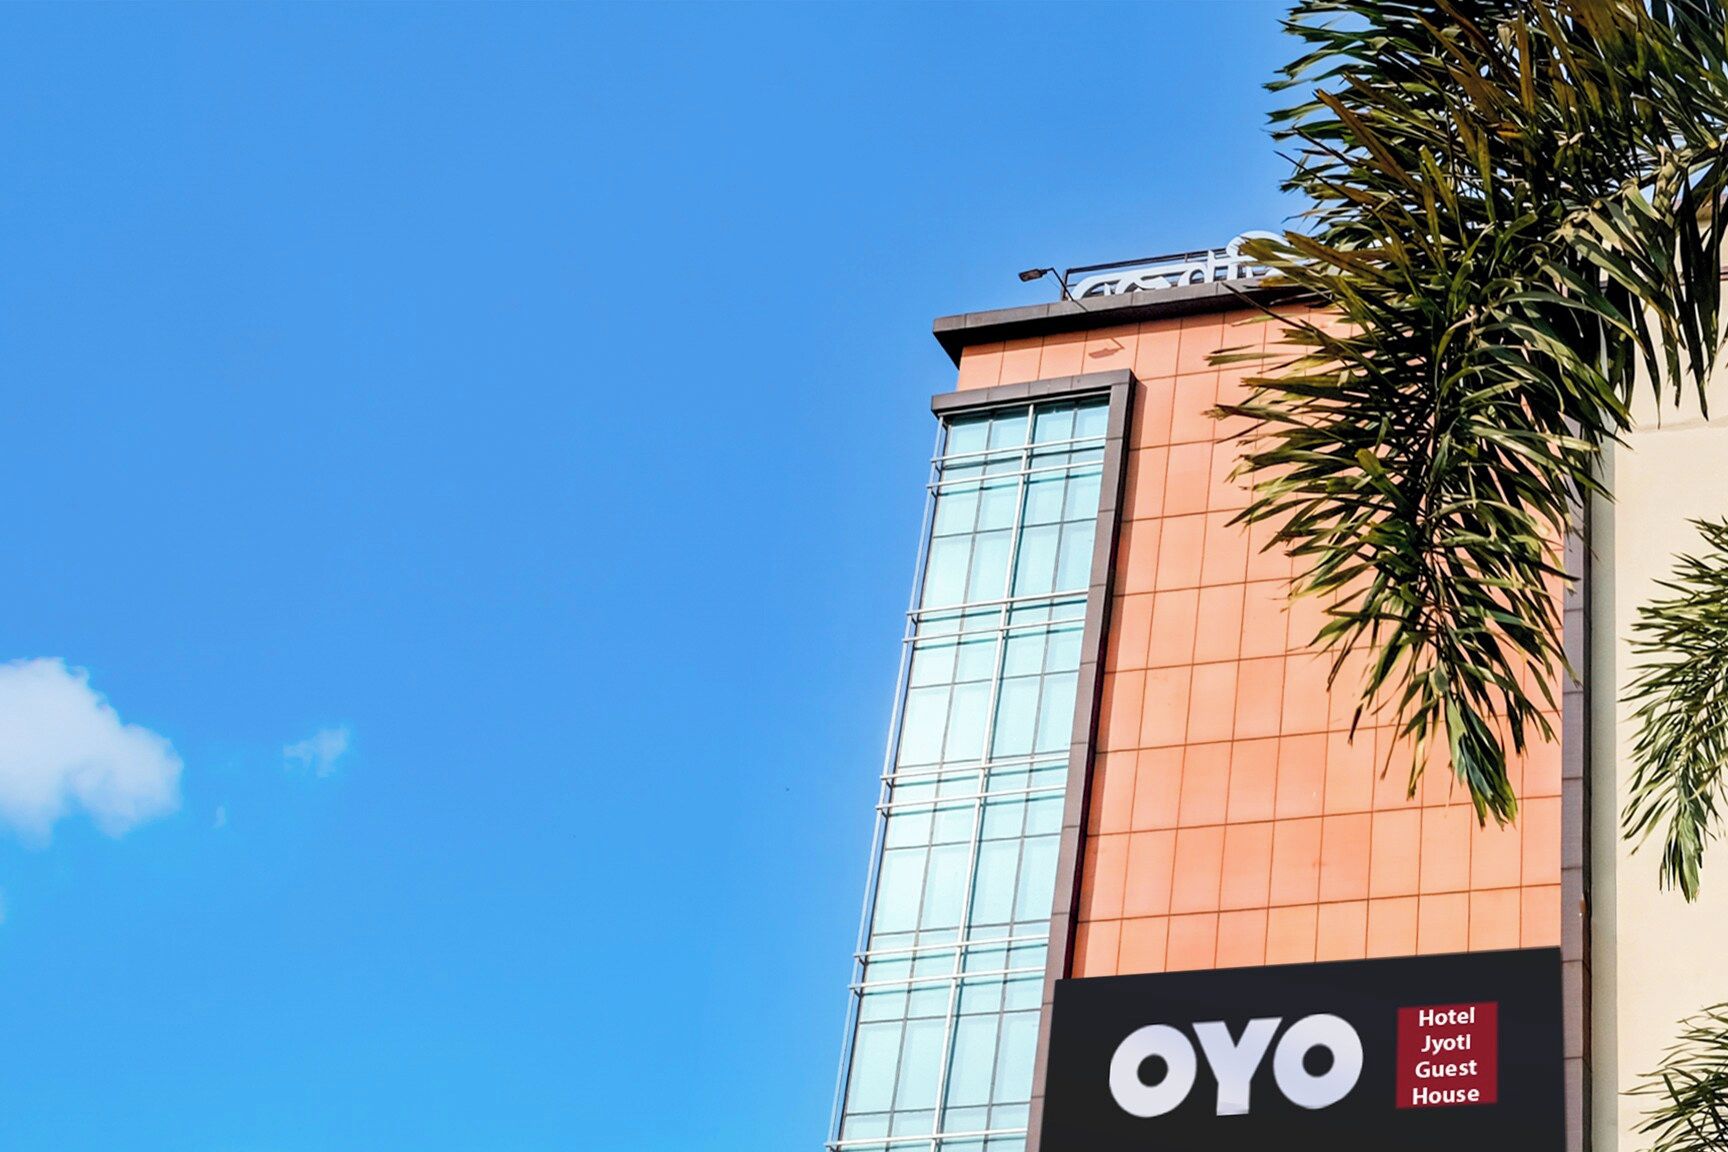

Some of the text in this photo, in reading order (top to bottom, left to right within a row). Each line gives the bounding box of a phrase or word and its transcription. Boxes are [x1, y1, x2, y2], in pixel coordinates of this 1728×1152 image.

[1419, 1006, 1475, 1027] Hotel
[1421, 1033, 1471, 1055] Jyoti
[1109, 1013, 1364, 1118] OYO
[1415, 1060, 1477, 1079] Guest
[1412, 1087, 1480, 1106] House
